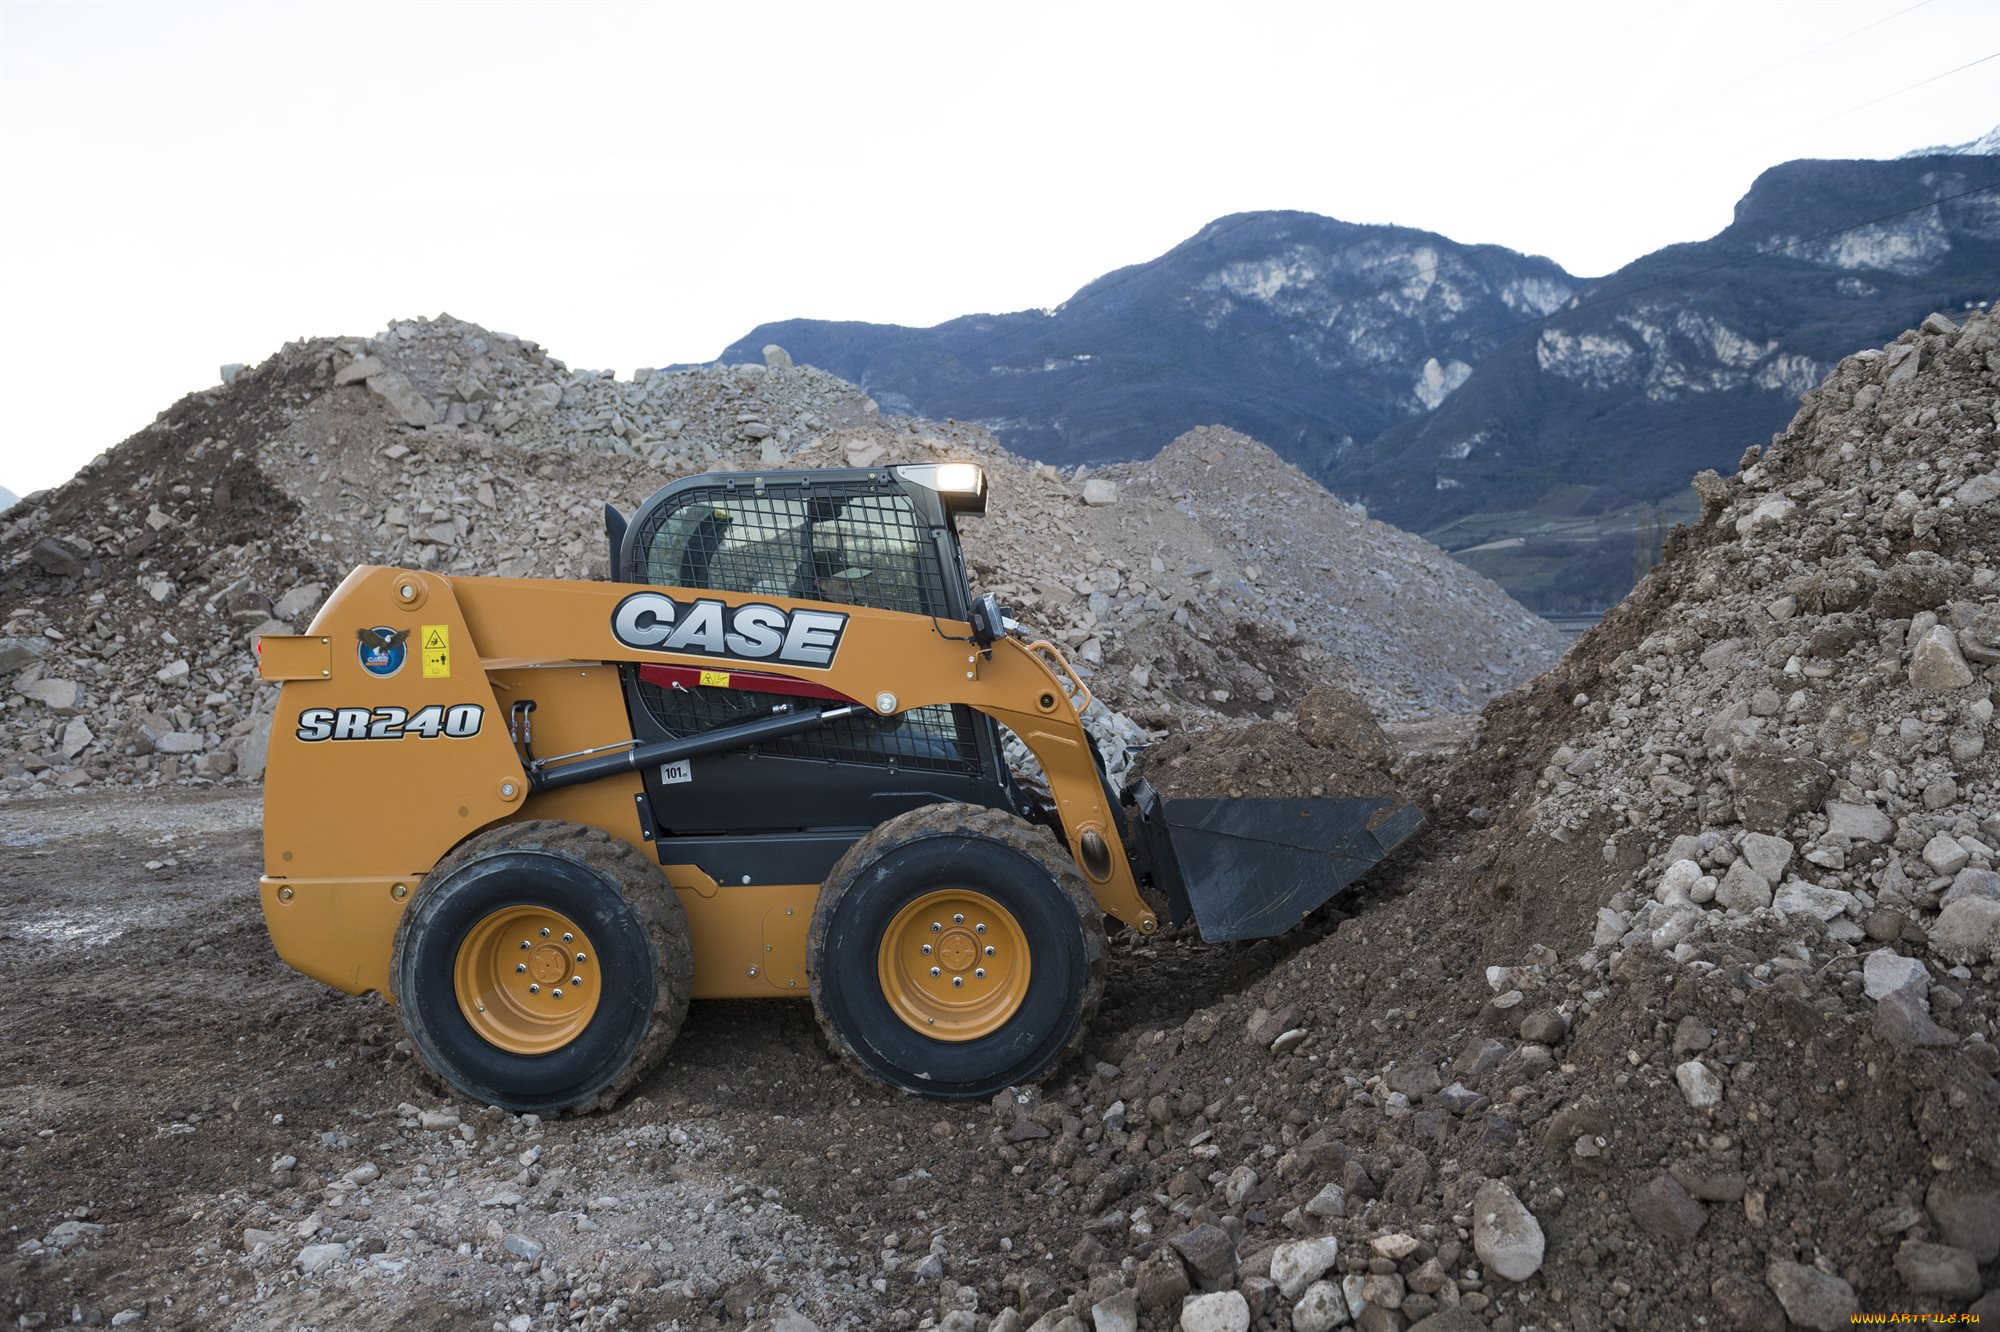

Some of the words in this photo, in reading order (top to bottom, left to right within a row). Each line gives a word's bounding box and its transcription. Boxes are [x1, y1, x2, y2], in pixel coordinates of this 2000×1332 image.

[614, 592, 845, 665] CASE
[297, 704, 484, 741] SR240
[665, 766, 682, 780] 101
